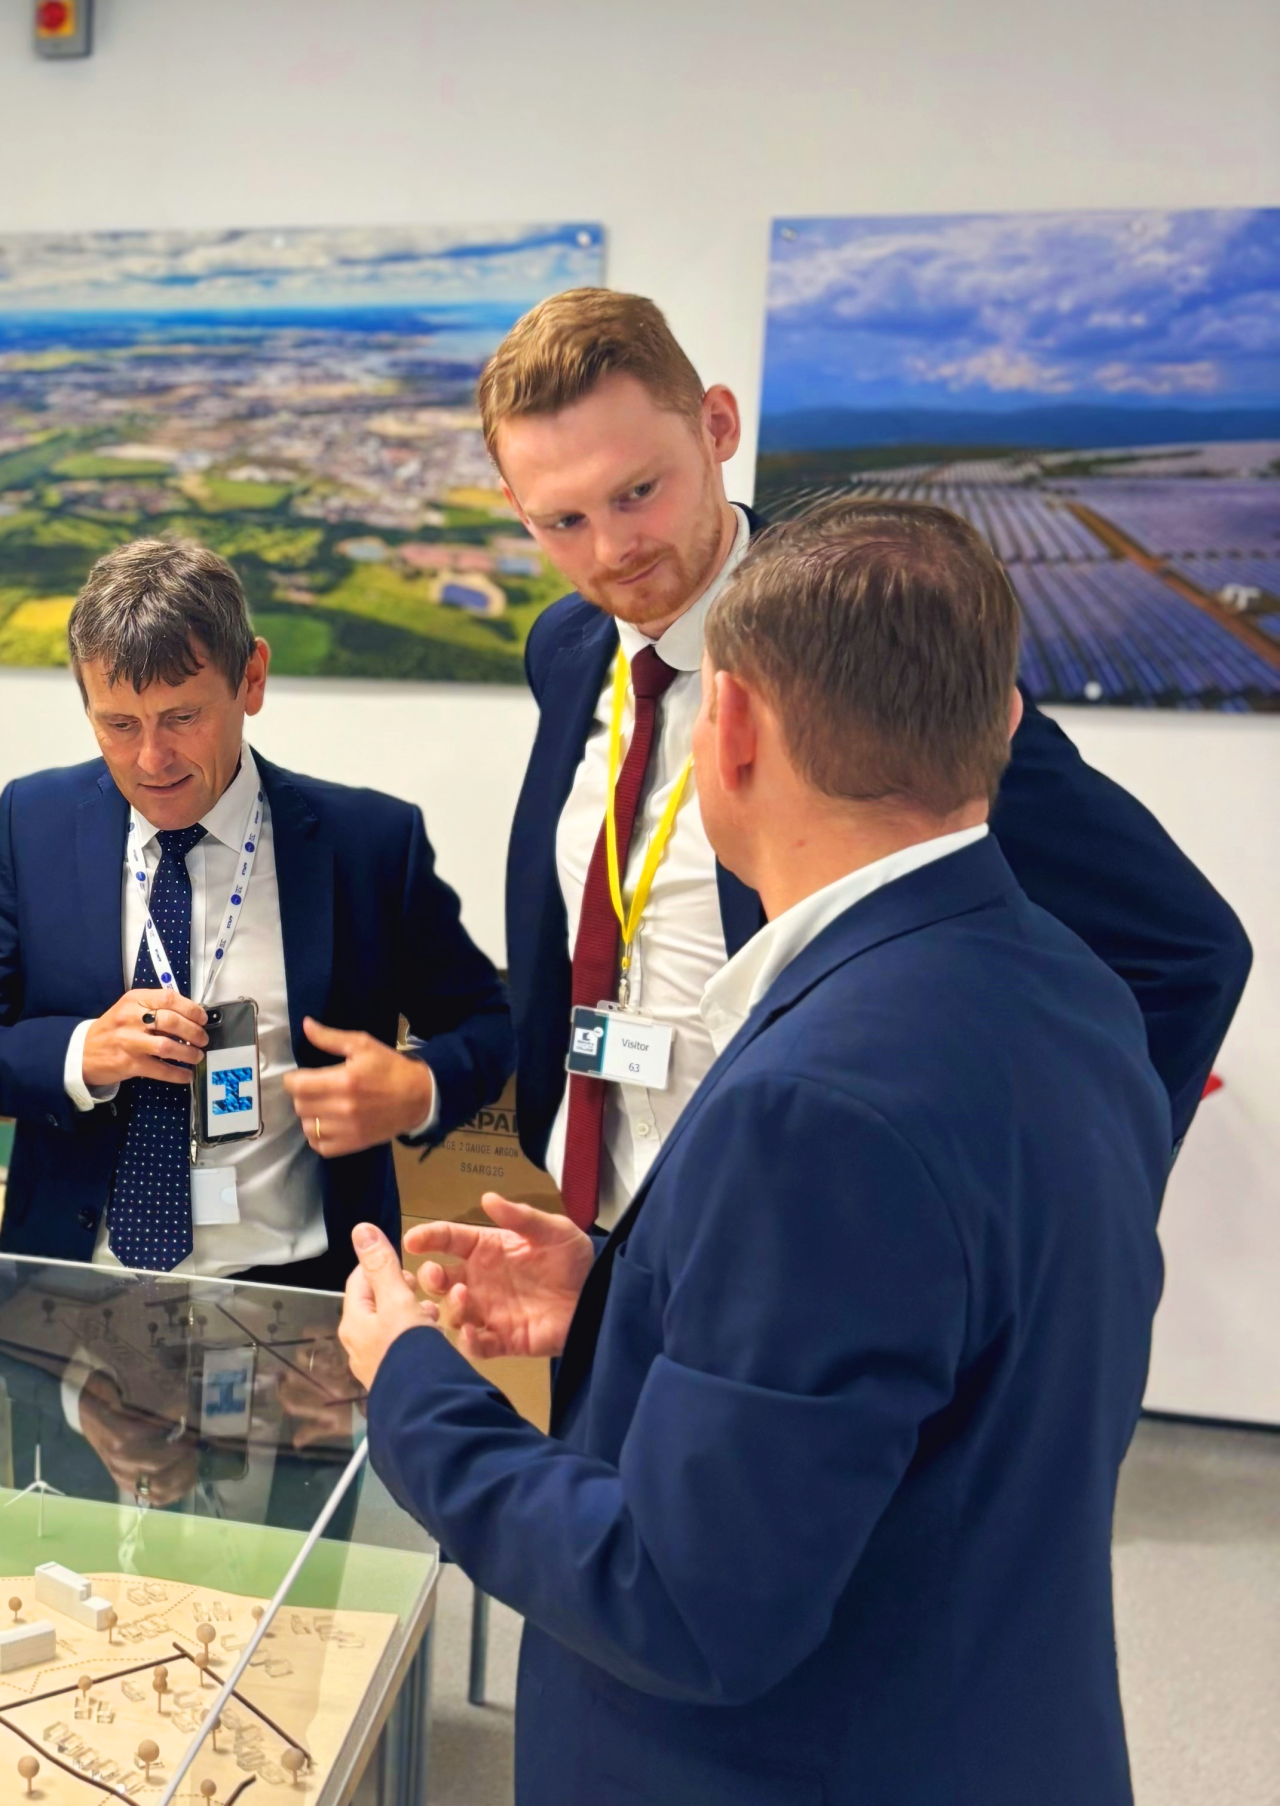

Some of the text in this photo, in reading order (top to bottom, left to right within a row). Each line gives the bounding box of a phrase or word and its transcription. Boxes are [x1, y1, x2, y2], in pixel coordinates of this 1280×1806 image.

[622, 1038, 649, 1051] Visitor
[629, 1062, 640, 1073] 63
[459, 1142, 464, 1151] 2
[465, 1142, 491, 1155] GAUGE
[494, 1146, 519, 1158] ARGON
[460, 1162, 504, 1177] SSARG2G
